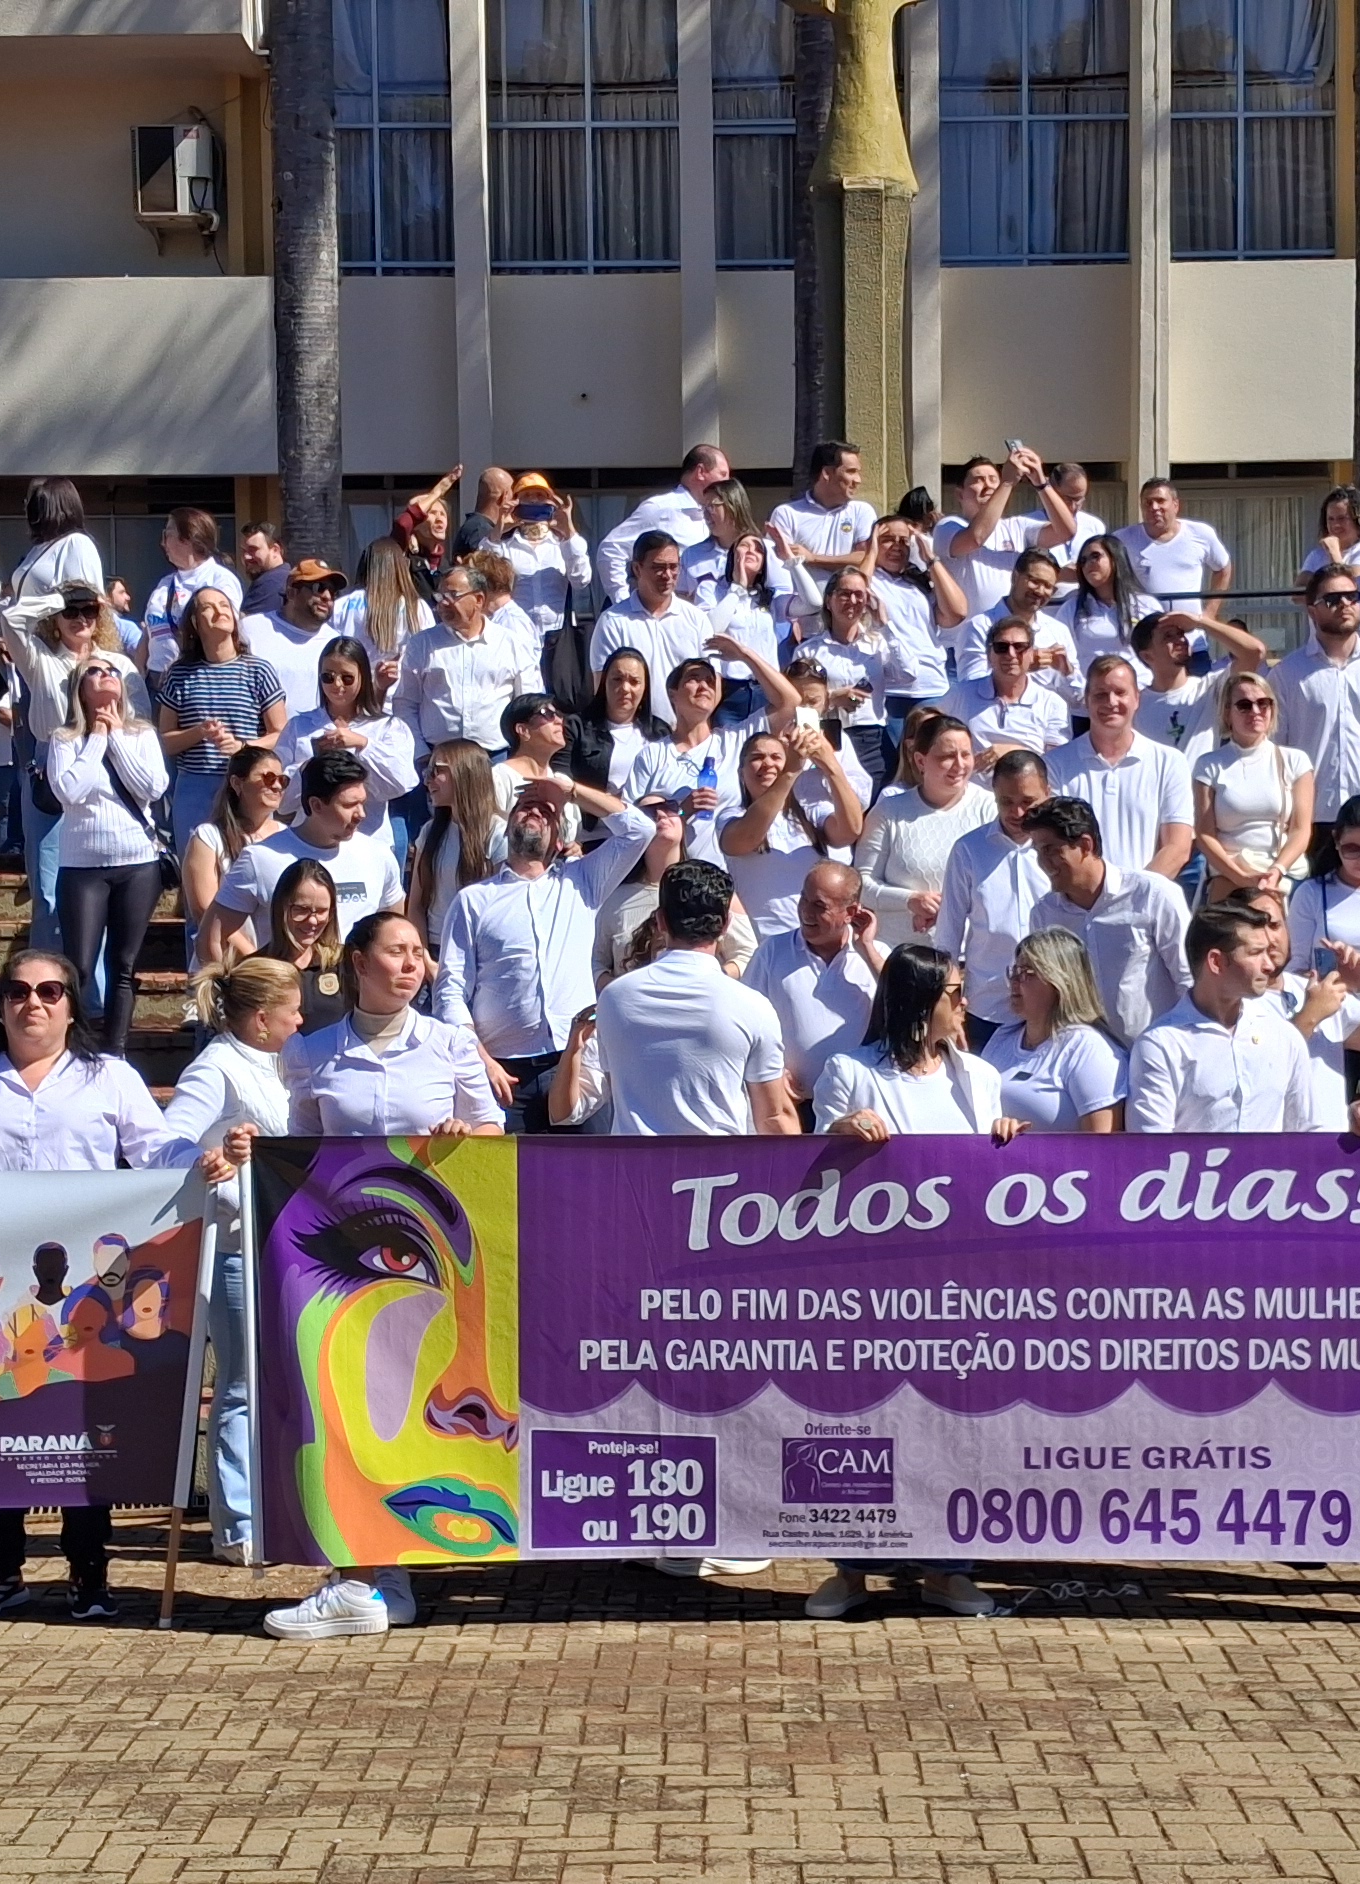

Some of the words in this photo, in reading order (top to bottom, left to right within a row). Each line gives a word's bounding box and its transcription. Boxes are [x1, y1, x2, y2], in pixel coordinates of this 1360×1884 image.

[671, 1168, 954, 1252] Todos
[984, 1170, 1090, 1227] os
[640, 1288, 722, 1321] PELO
[732, 1288, 788, 1320] FIM
[798, 1288, 862, 1320] DAS
[869, 1280, 1058, 1320] VIOLÊNCIAS
[1066, 1287, 1195, 1320] CONTRA
[1201, 1287, 1245, 1320] AS
[579, 1339, 658, 1371] PELA
[664, 1339, 818, 1371] GARANTIA
[826, 1339, 845, 1371] E
[853, 1331, 1016, 1379] PROTEÇÃO
[1024, 1339, 1091, 1371] DOS
[1099, 1338, 1239, 1371] DIREITOS
[1248, 1338, 1312, 1371] DAS
[0, 1432, 93, 1452] PARANÁ
[804, 1422, 871, 1436] Oriente-se
[588, 1440, 659, 1457] Proteja-se!
[818, 1448, 891, 1474] CAM
[1023, 1446, 1131, 1470] LIGUE
[1142, 1439, 1272, 1470] GRÁTIS
[541, 1470, 615, 1503] Ligue
[627, 1459, 704, 1497] 180
[582, 1520, 618, 1542] ou
[630, 1503, 706, 1541] 190
[778, 1511, 806, 1523] Fone
[808, 1508, 851, 1523] 3422
[855, 1508, 897, 1523] 4479
[946, 1488, 1082, 1544] 0800
[1099, 1488, 1201, 1545] 645
[1216, 1488, 1352, 1546] 4479
[762, 1530, 779, 1538] Rua
